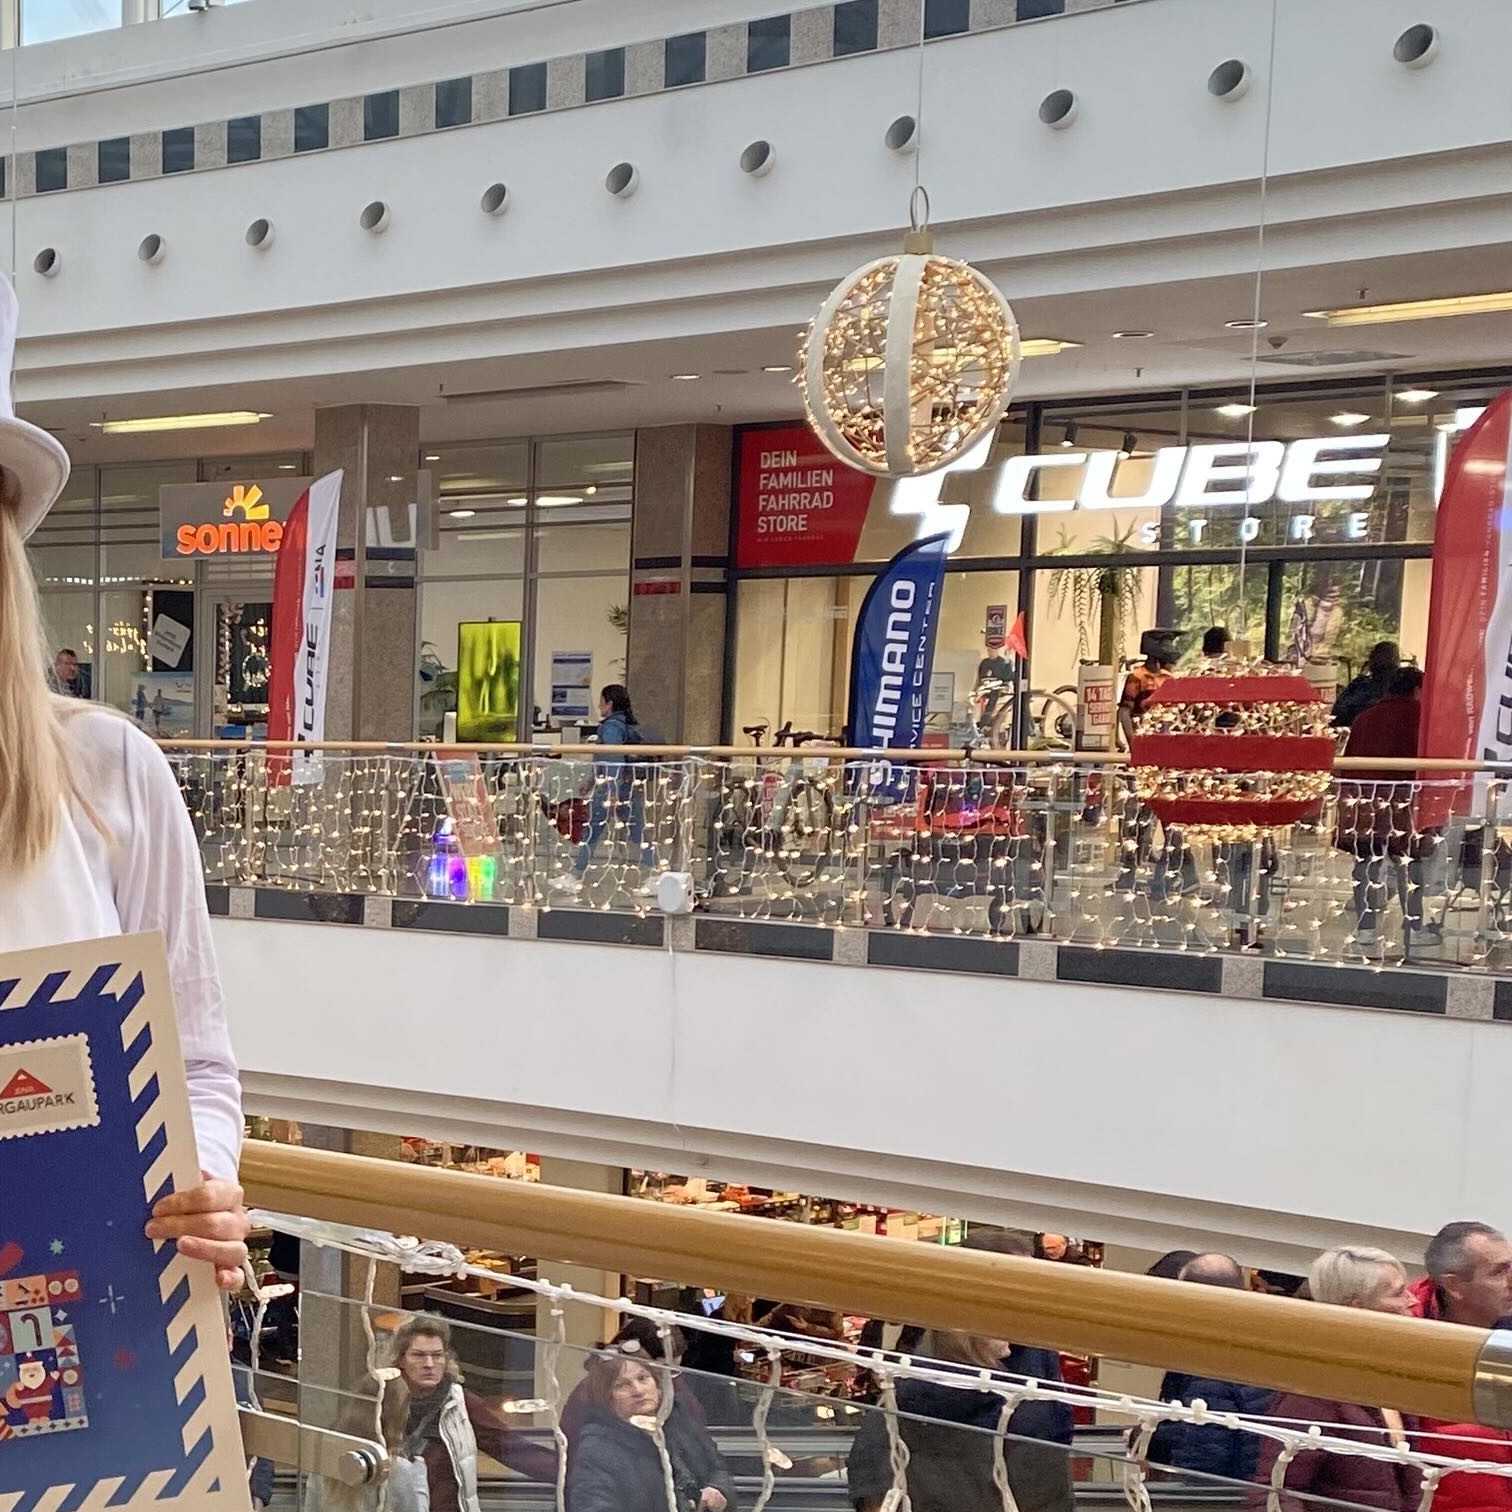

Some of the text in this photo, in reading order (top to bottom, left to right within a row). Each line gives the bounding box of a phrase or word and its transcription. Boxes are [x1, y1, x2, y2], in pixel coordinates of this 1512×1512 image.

[760, 450, 797, 469] DEIN
[759, 469, 833, 490] FAMILIEN
[996, 434, 1390, 513] CUBE
[758, 491, 833, 512] FAHRRAD
[757, 514, 808, 534] STORE
[1141, 512, 1370, 544] STORE
[176, 521, 286, 555] sonne
[912, 581, 936, 687] CENTER
